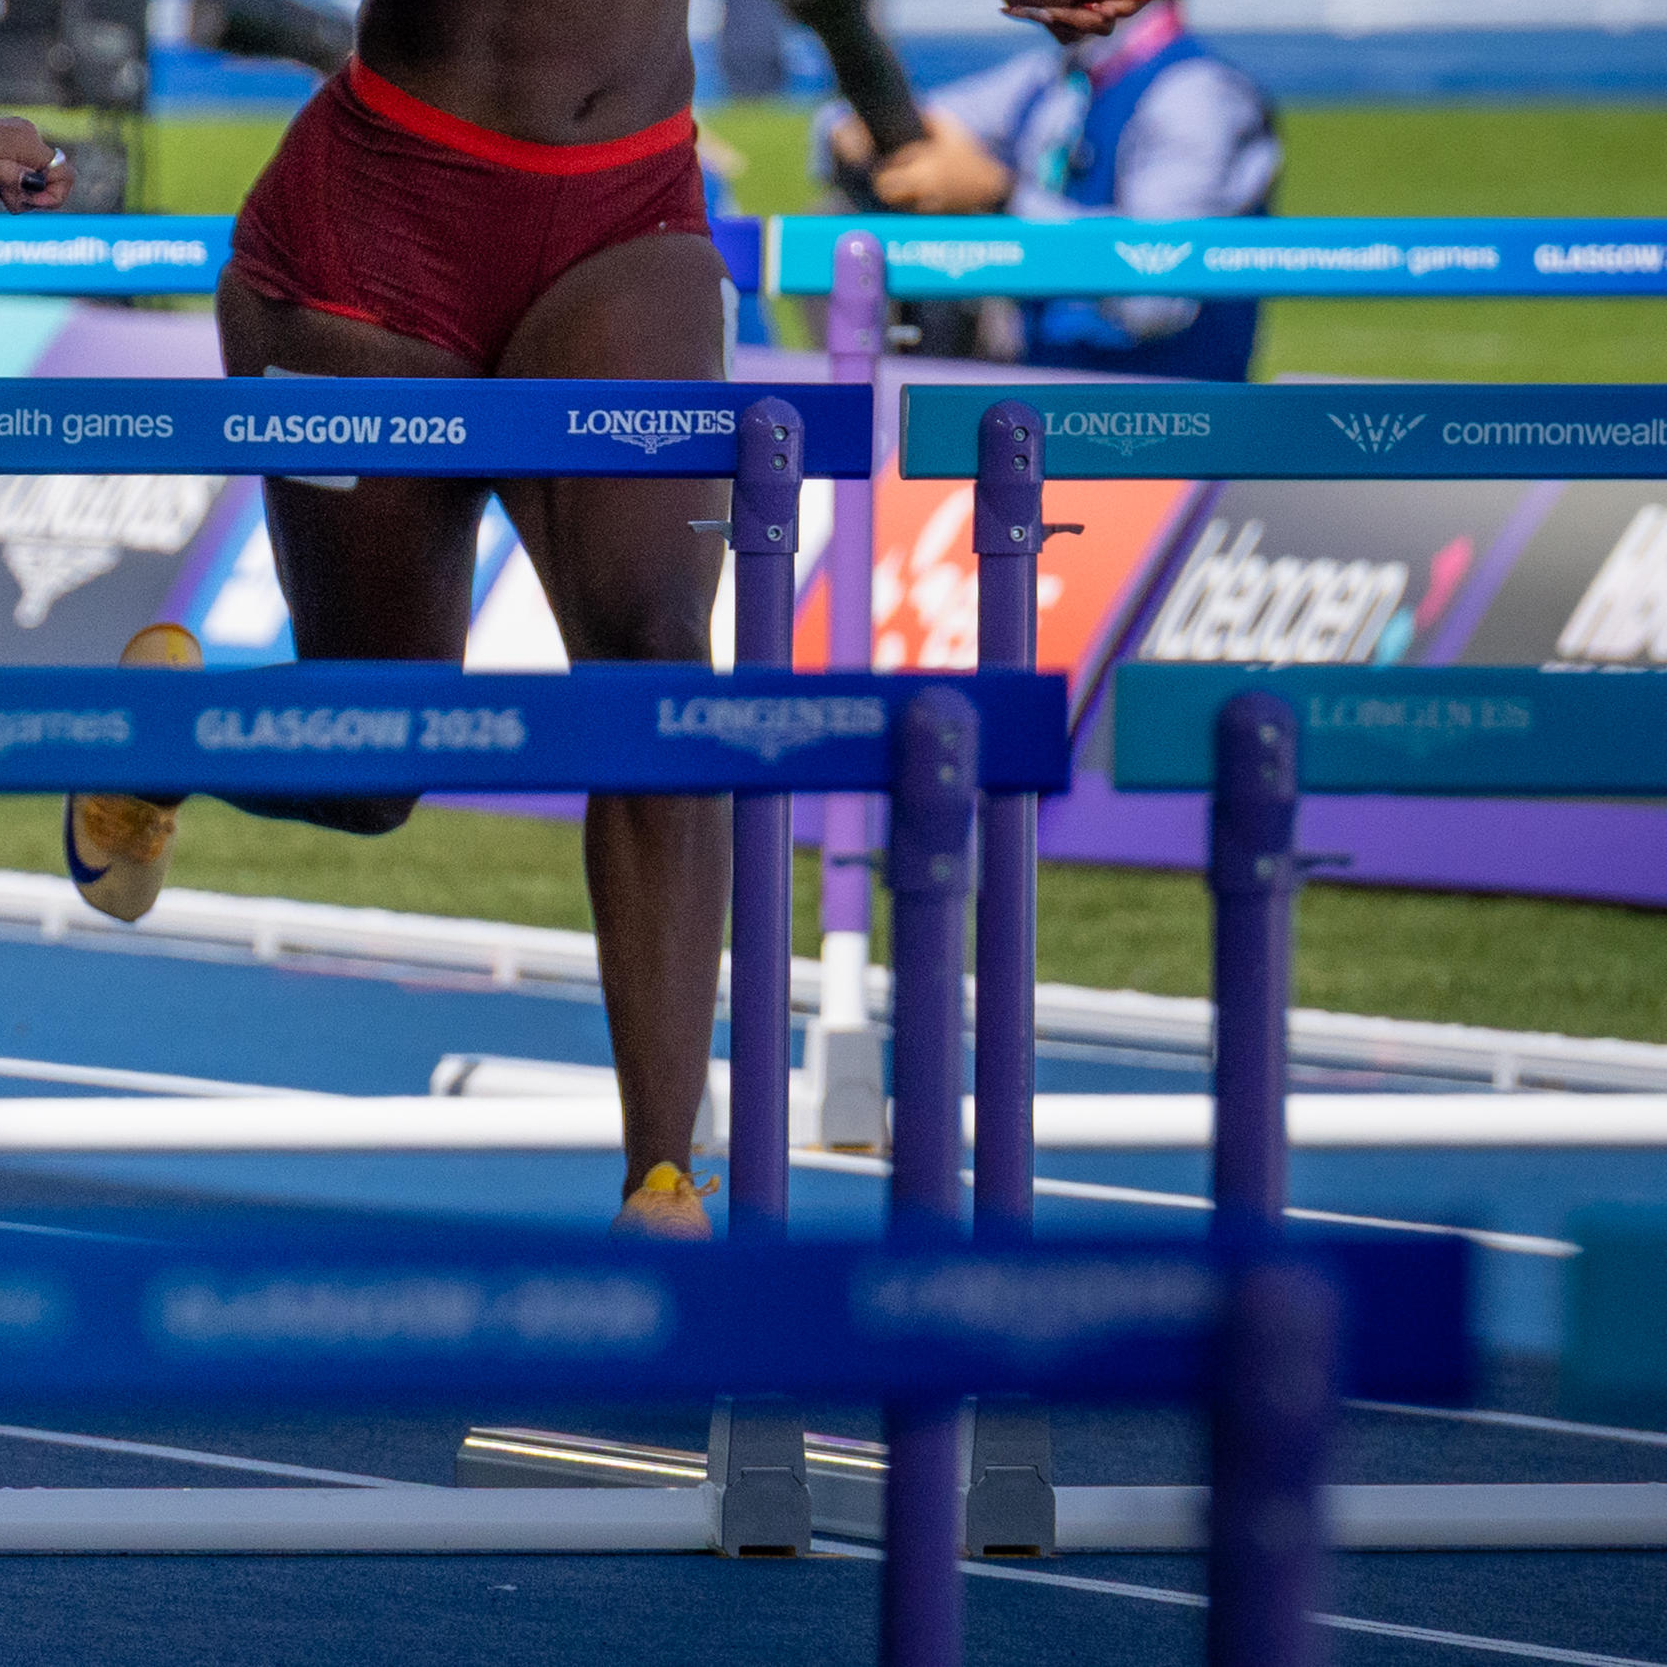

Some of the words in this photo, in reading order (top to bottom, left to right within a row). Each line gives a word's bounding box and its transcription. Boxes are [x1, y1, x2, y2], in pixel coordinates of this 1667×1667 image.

[62, 412, 173, 444] games
[223, 415, 380, 444] GLASGOW
[389, 416, 467, 444] 2026
[567, 409, 736, 435] LONGINES
[1043, 412, 1211, 436] LONGINES
[1442, 417, 1667, 446] commonwealt
